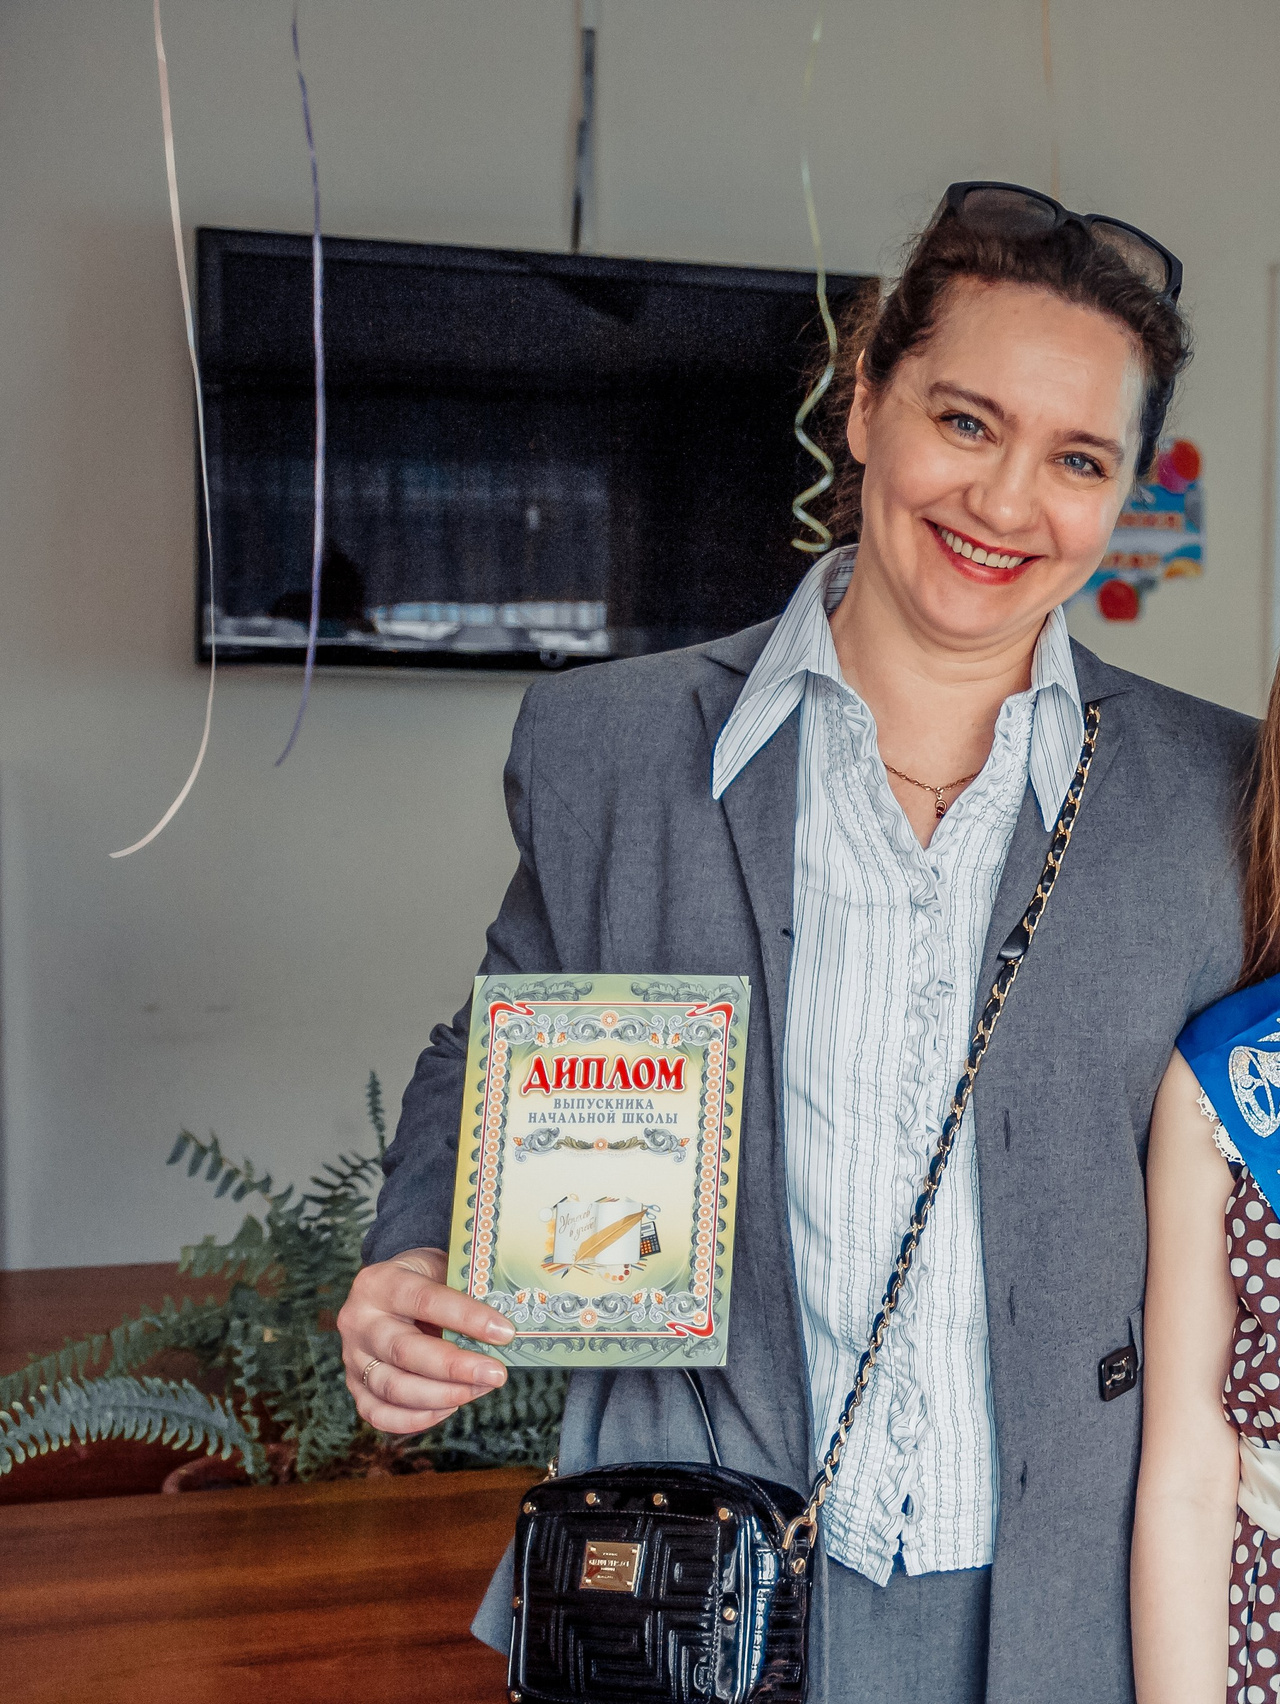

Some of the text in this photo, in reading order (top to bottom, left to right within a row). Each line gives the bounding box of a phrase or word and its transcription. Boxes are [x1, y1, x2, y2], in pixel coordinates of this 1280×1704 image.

[521, 1054, 687, 1095] ДИПЛОМ
[553, 1098, 655, 1111] ВЫПУСКНИКА
[528, 1109, 678, 1125] НАЧАЛЬНОЙ ШКОЛЫ
